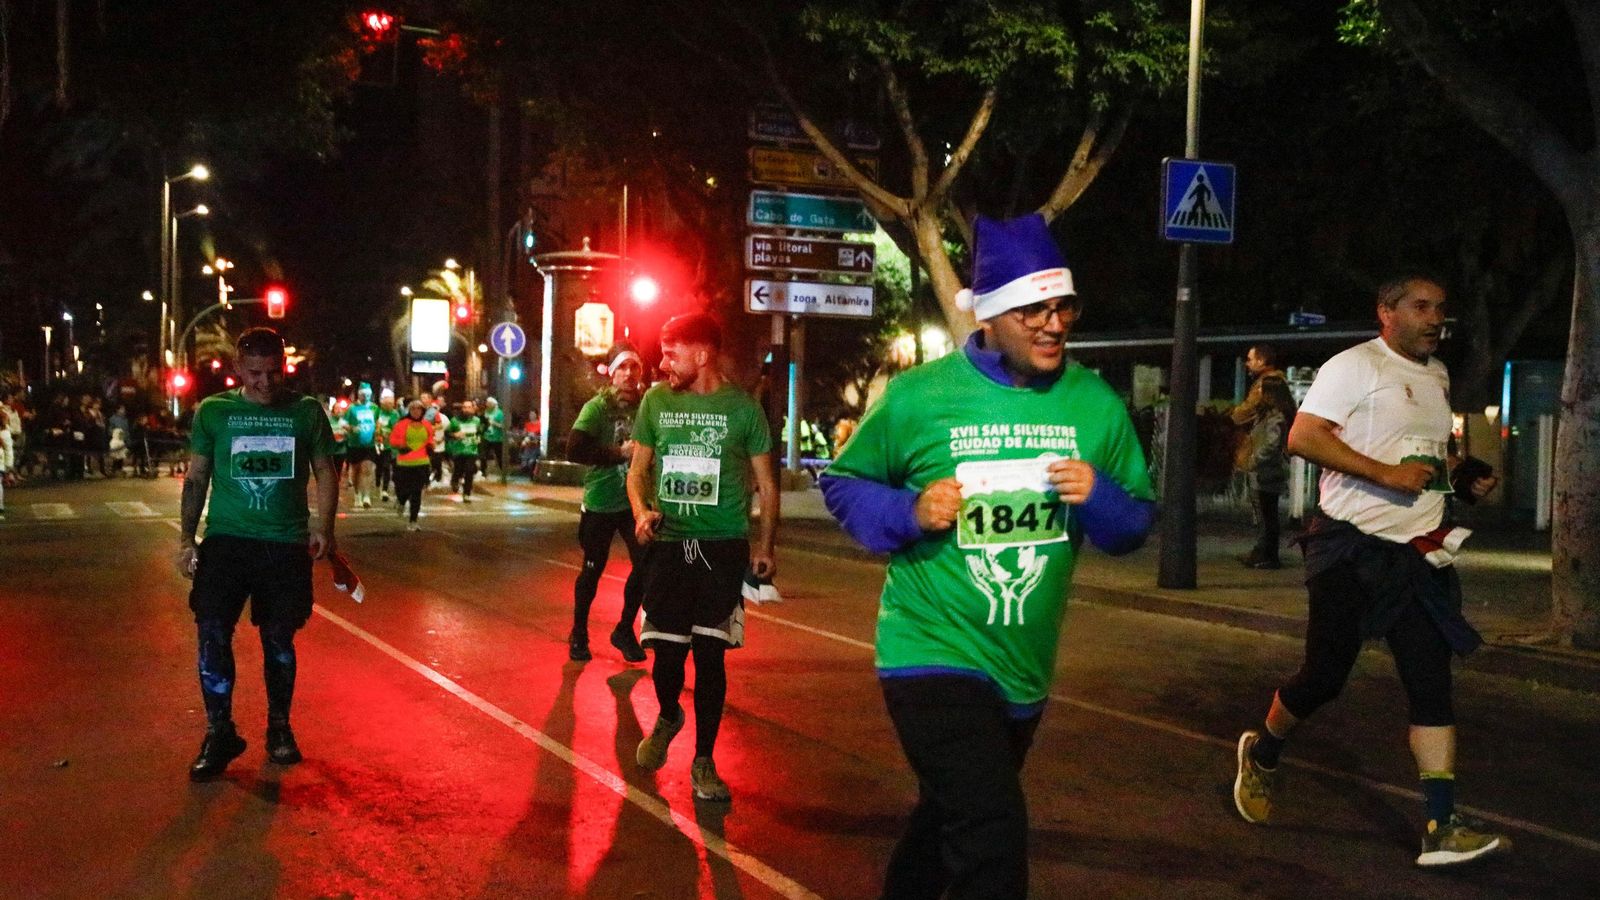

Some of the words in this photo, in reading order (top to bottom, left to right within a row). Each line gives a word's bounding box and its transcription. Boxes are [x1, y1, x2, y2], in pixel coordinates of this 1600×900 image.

[755, 208, 783, 221] Cabo
[790, 211, 803, 223] de
[810, 214, 835, 226] Gata
[779, 241, 812, 254] litoral
[755, 251, 791, 264] playas
[793, 295, 817, 305] zona
[825, 294, 869, 307] Altamira
[659, 411, 673, 419] XVII
[675, 412, 689, 420] SAN
[691, 413, 728, 421] SILVESTRE
[659, 418, 684, 426] CIUDAD
[950, 425, 979, 439] XVII
[982, 424, 1010, 437] SAN
[1013, 423, 1077, 438] SILVESTRE
[949, 437, 1002, 451] CIUDAD
[1004, 436, 1023, 449] DE
[1025, 434, 1078, 450] ALMERÍA
[241, 457, 282, 473] 435
[664, 478, 713, 498] 1869
[966, 501, 1060, 535] 1847
